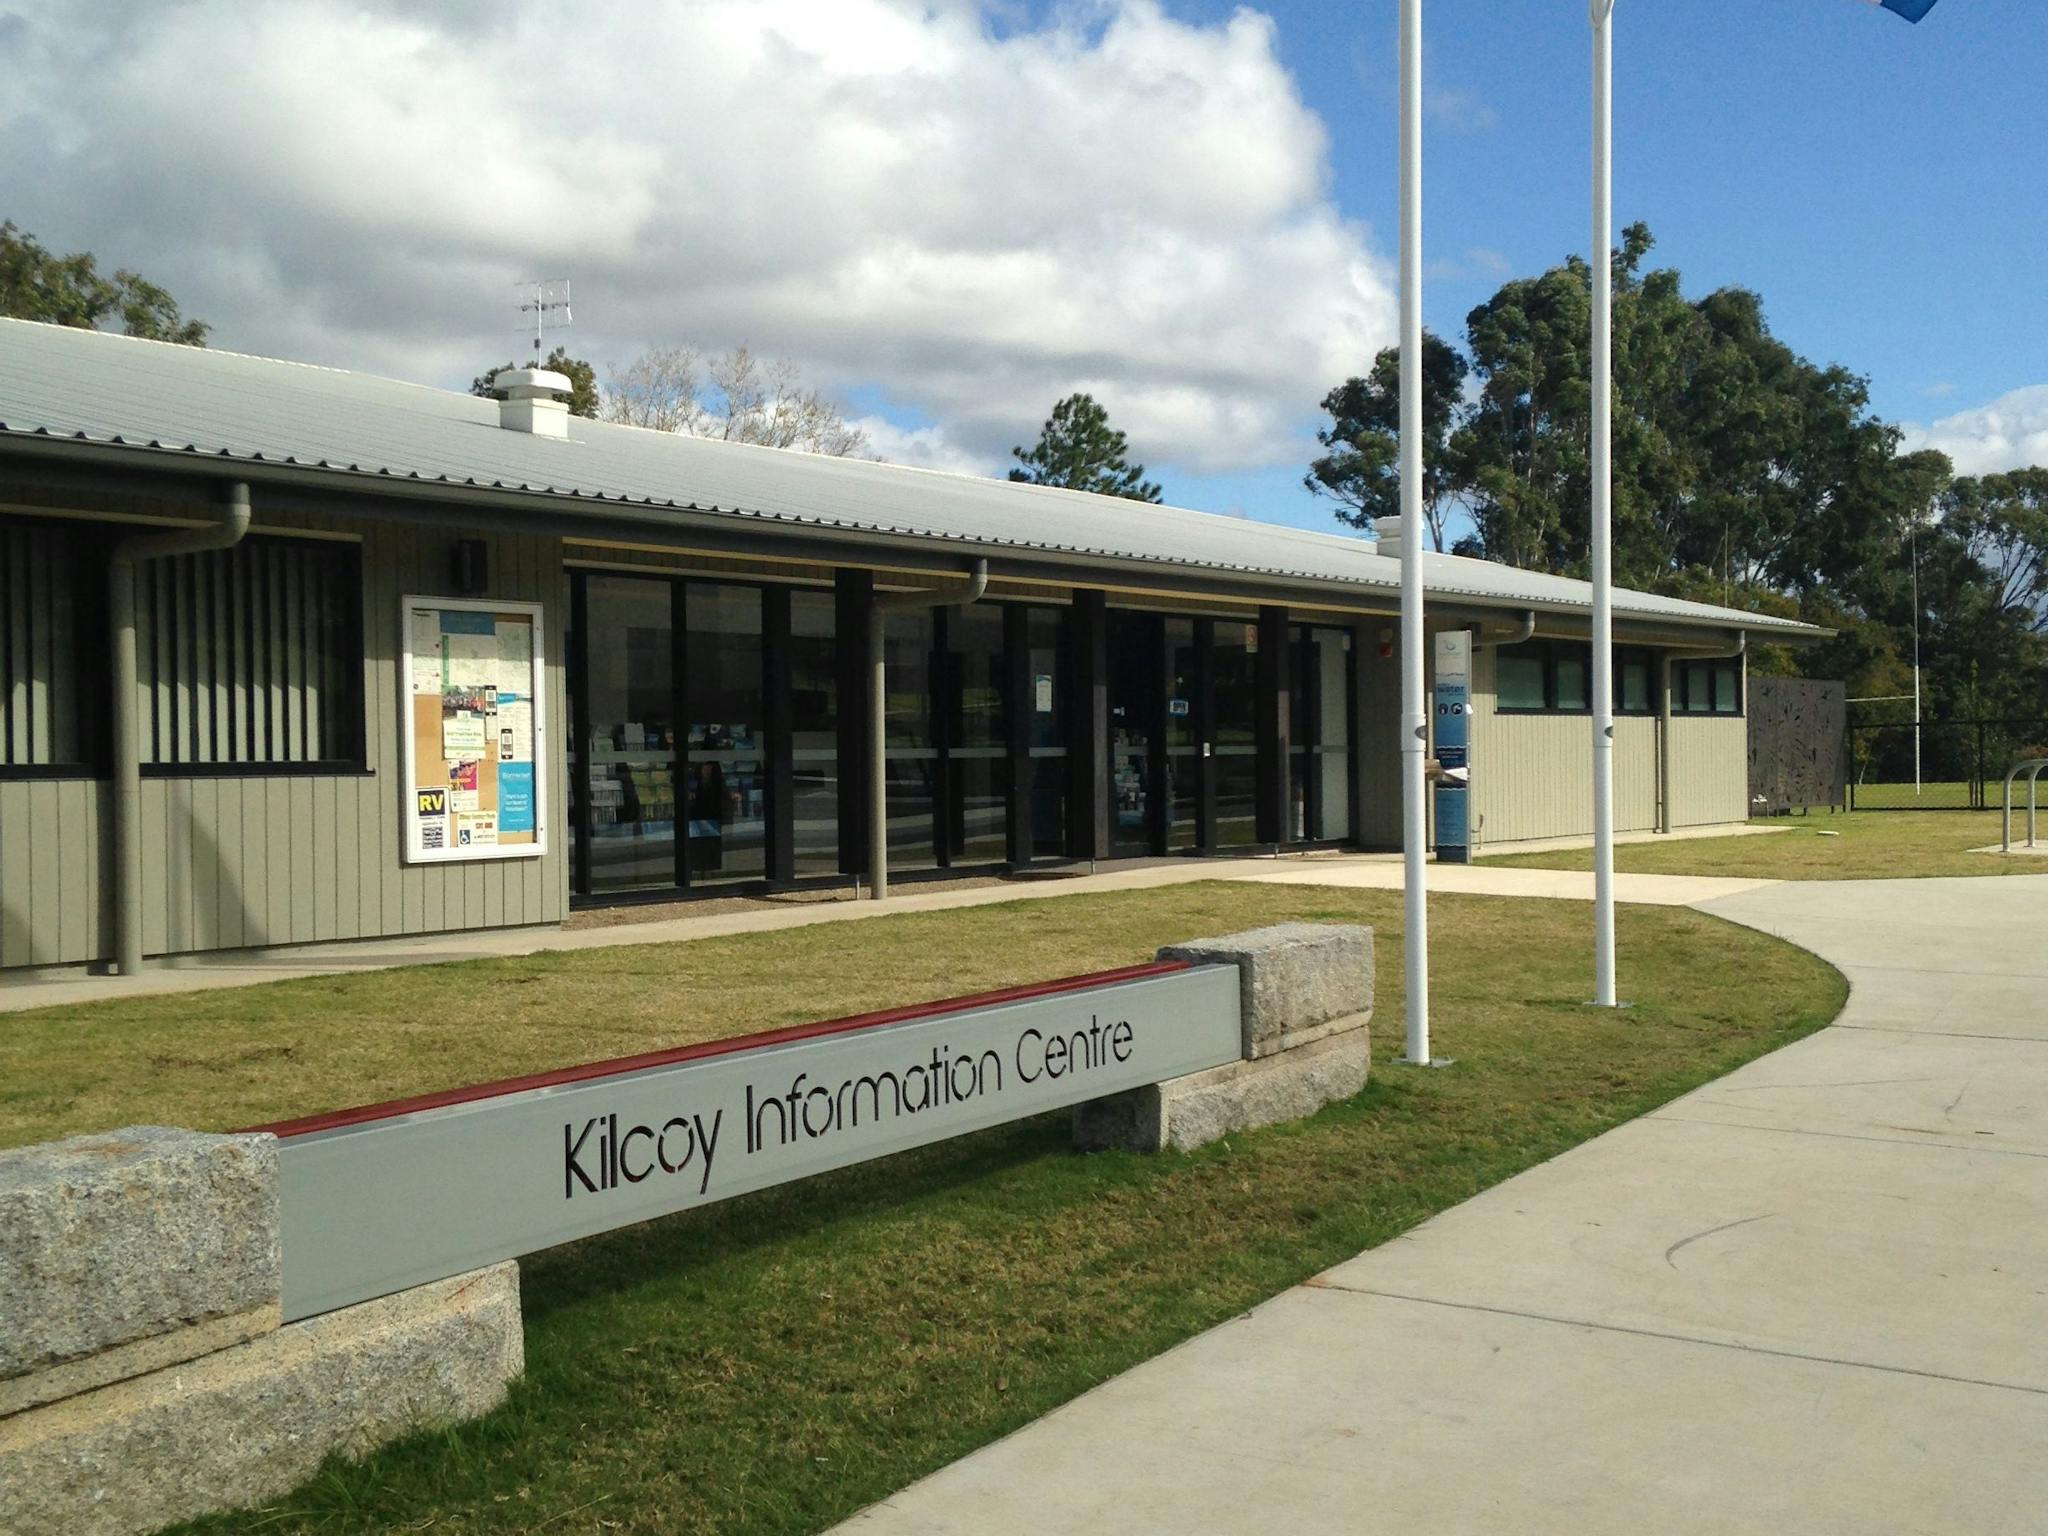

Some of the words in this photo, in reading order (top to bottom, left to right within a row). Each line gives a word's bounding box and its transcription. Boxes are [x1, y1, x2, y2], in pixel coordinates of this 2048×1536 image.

[419, 794, 444, 811] RV
[564, 1109, 723, 1199] Kilcoy
[745, 1045, 1002, 1154] Information
[1016, 1014, 1133, 1084] Centre
